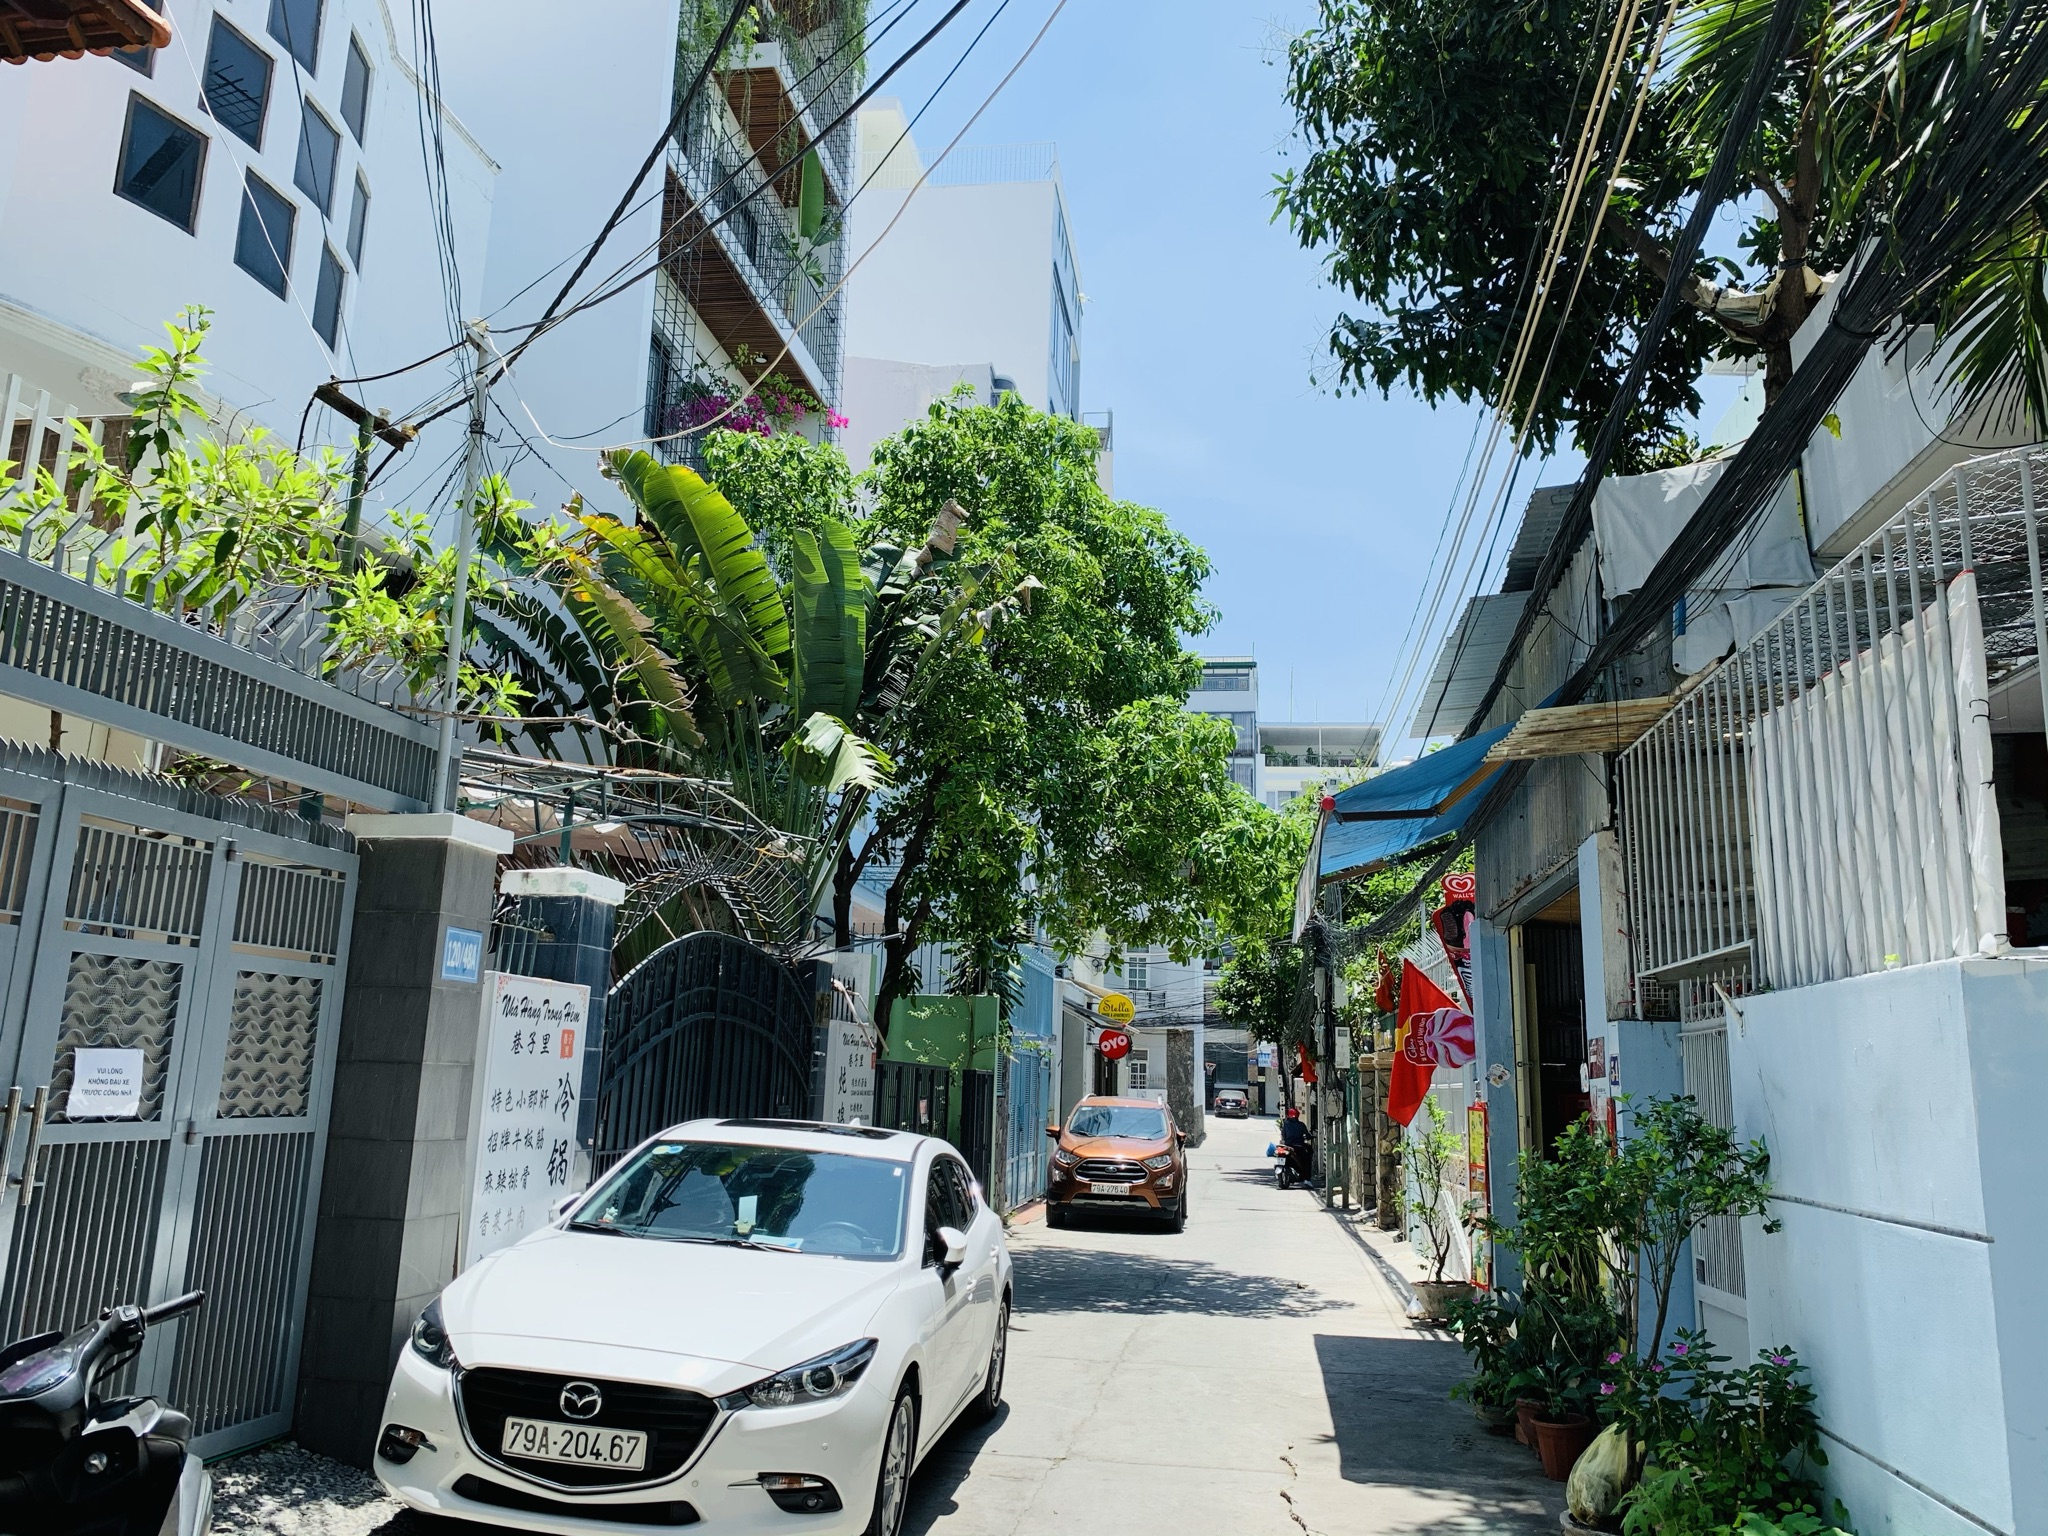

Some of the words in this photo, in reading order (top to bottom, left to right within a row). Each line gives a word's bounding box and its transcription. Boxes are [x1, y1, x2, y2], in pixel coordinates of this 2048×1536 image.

[501, 993, 519, 1018] Nhà
[520, 996, 541, 1026] Hàng
[543, 998, 563, 1028] Trong
[1102, 1000, 1131, 1013] Stella
[1101, 1035, 1128, 1053] OYO
[122, 1078, 130, 1086] XE
